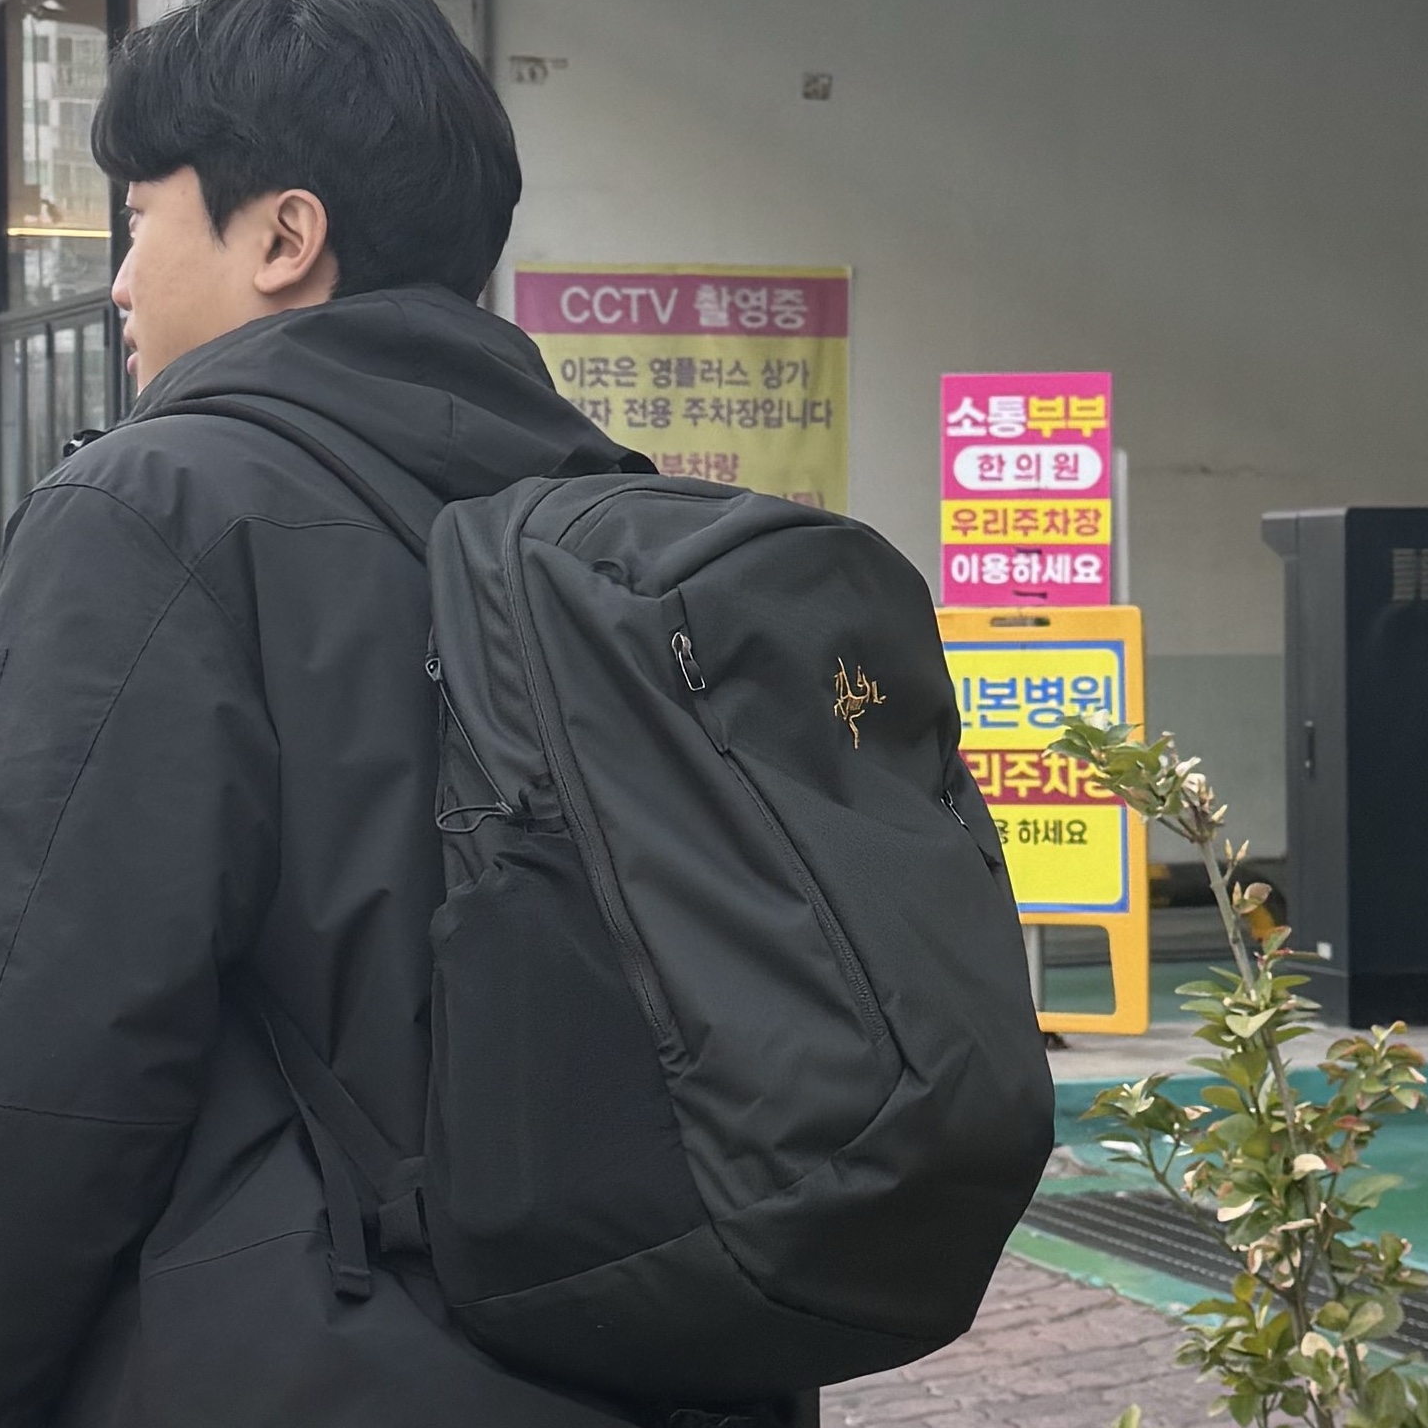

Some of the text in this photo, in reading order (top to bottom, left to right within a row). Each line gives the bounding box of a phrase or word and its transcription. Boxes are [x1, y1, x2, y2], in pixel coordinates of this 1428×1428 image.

[560, 284, 807, 329] CCTV 촬영중
[561, 356, 809, 389] 이곳은 영플러스 상가
[576, 398, 831, 429] 자 전용 주차장입니다
[946, 395, 1106, 438] 소통부부
[651, 452, 739, 483] 부차량
[977, 453, 1080, 481] 한의원
[952, 508, 1101, 537] 우리주차장
[952, 554, 1102, 584] 이용하세요
[1018, 819, 1087, 845] 하세요
